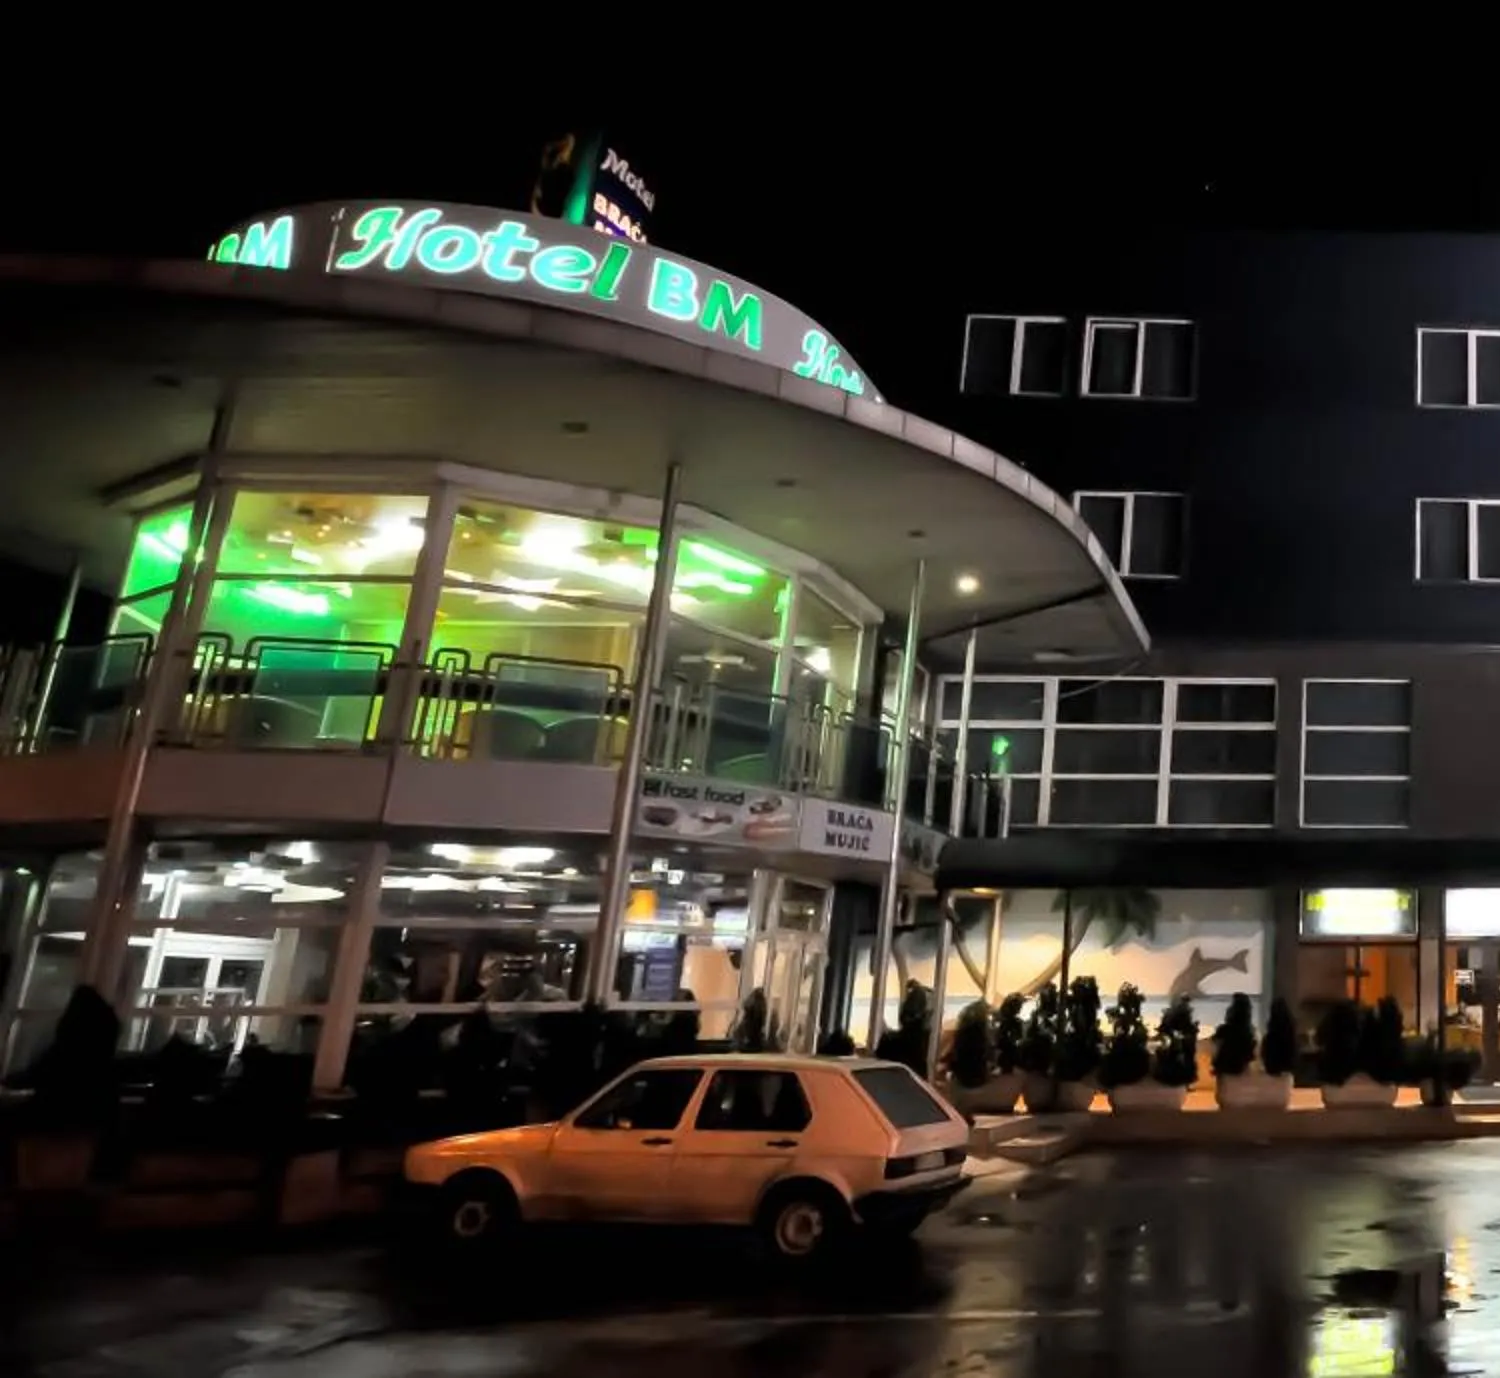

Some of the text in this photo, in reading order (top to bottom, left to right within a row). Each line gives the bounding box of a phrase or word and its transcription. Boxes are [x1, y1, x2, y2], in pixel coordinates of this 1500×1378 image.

[600, 148, 656, 212] Motel
[336, 207, 762, 350] Hotel BM
[705, 786, 745, 806] food
